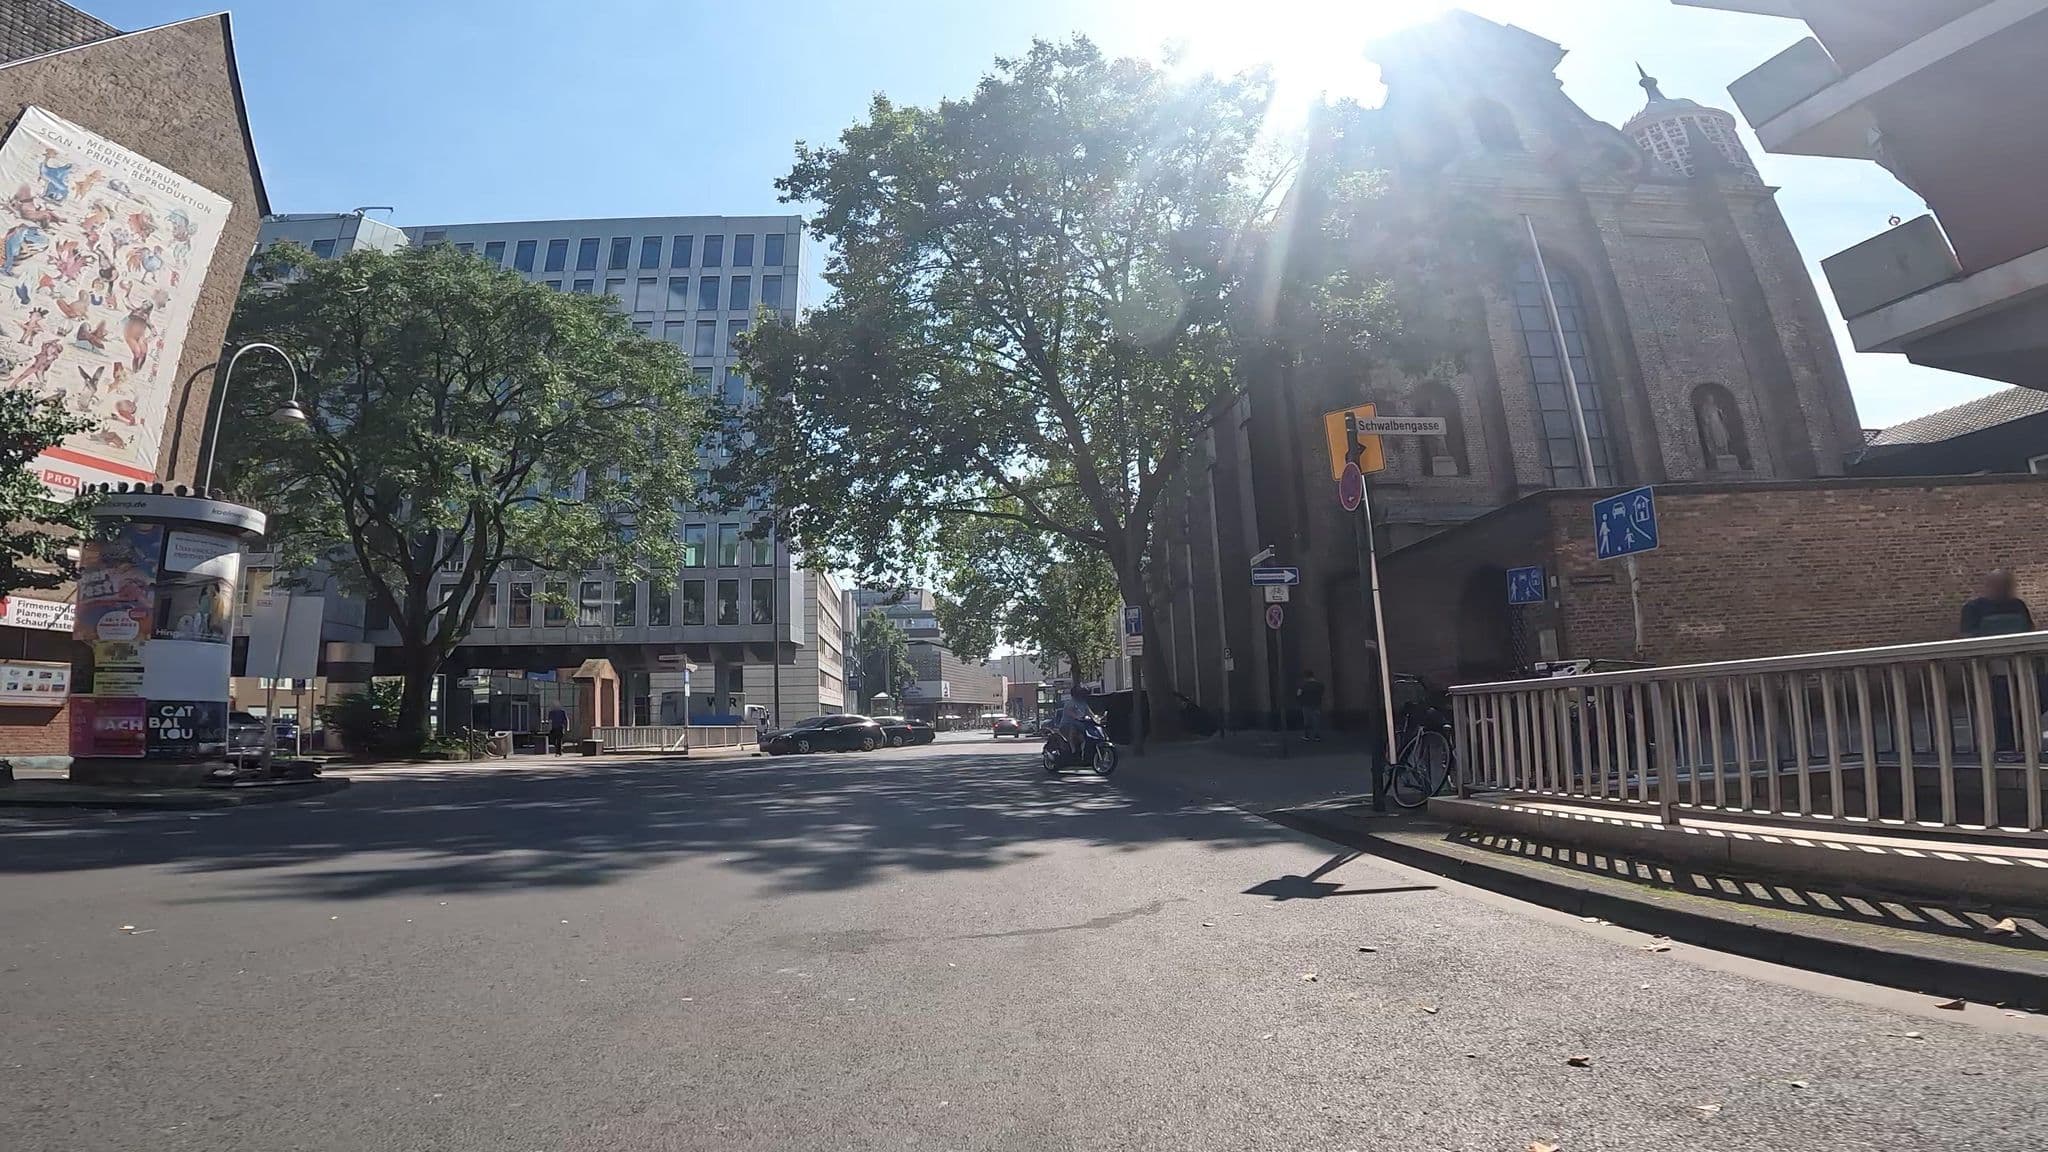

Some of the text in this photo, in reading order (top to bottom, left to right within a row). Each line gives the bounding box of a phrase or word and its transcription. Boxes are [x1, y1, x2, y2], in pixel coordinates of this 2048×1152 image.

[86, 138, 181, 189] MEDIENZENTRUM
[39, 127, 212, 214] SCAN PRINT REPRODUKTION
[1358, 420, 1440, 433] Schwalbengasse
[15, 617, 72, 629] Schaufnste
[160, 705, 194, 717] CAT
[96, 718, 143, 731] ACH
[149, 717, 181, 729] BAL
[159, 728, 193, 740] LOU
